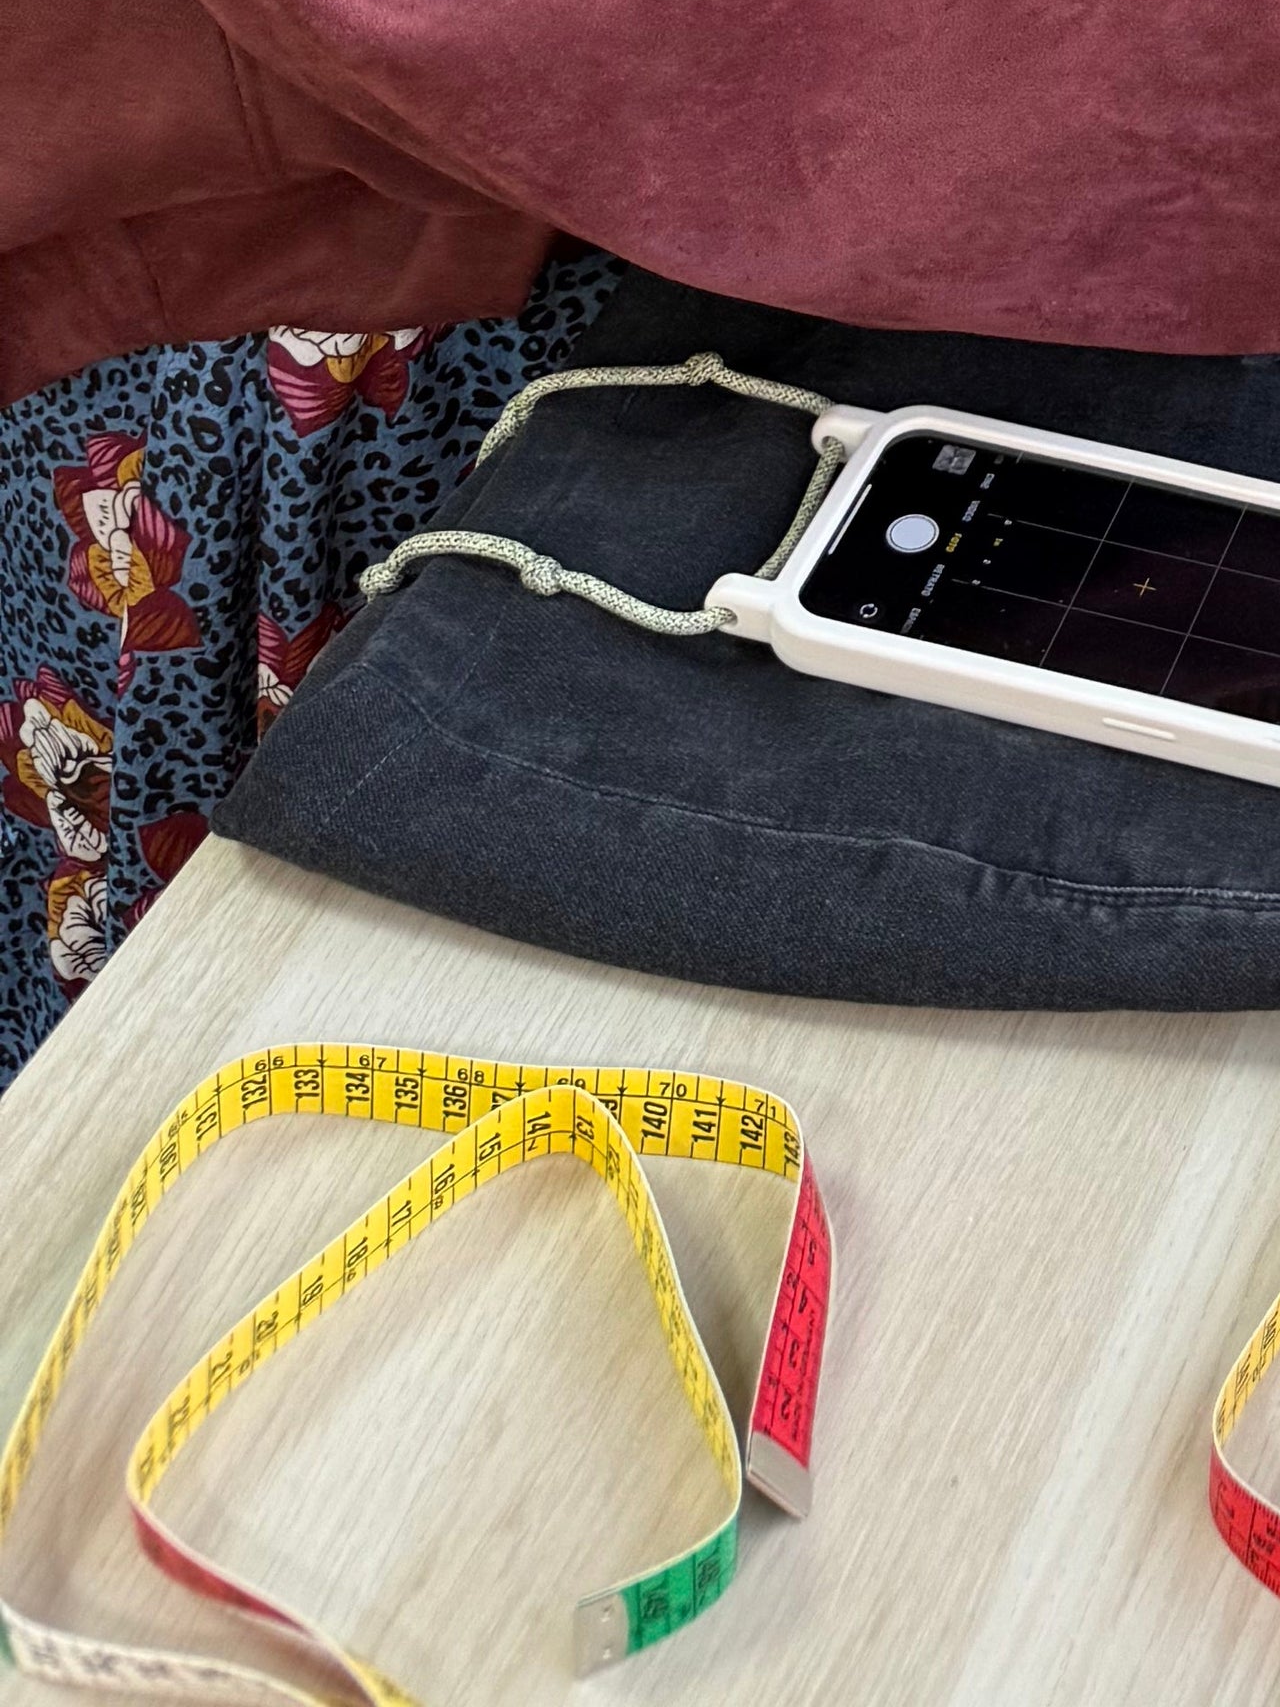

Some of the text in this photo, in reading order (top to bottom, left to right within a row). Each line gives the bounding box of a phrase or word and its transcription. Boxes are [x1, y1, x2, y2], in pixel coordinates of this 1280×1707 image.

[921, 564, 945, 597] RETRATO
[255, 1056, 284, 1073] 66
[359, 1054, 387, 1069] 67
[457, 1068, 485, 1084] 68
[659, 1082, 688, 1097] 70
[753, 1099, 776, 1119] 71
[195, 1102, 218, 1141] 131
[241, 1074, 268, 1111] 132
[294, 1068, 320, 1099] 133
[345, 1072, 370, 1103] 134
[394, 1076, 419, 1110] 135
[443, 1084, 468, 1119] 136
[642, 1100, 668, 1140] 140
[692, 1108, 718, 1143] 141
[739, 1113, 764, 1152] 142
[527, 1111, 552, 1136] 14
[575, 1115, 595, 1141] 13
[479, 1132, 501, 1161] 15
[434, 1164, 455, 1195] 16
[391, 1199, 412, 1227] 17
[347, 1237, 368, 1268] 18
